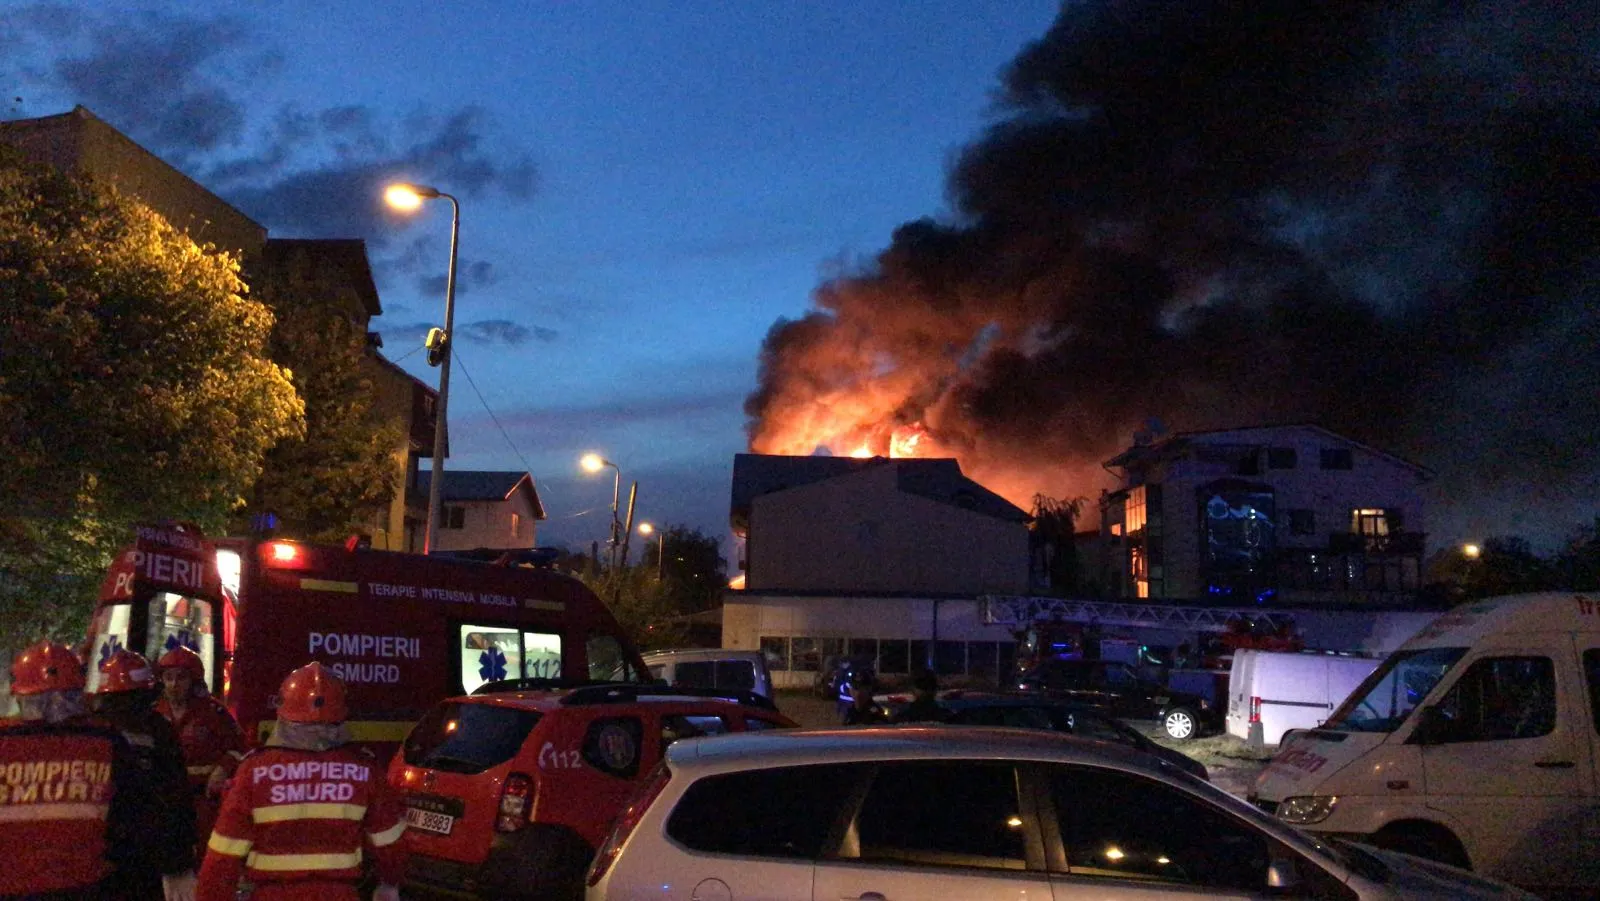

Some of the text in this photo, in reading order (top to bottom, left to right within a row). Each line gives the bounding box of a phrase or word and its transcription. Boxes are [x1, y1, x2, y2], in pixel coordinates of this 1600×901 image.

[368, 583, 517, 607] TERAPIE INTENSIVA MOBILA
[308, 632, 421, 659] POMPIERII
[323, 663, 400, 684] SMURD
[552, 750, 582, 769] 112
[253, 761, 370, 784] POMPIERII
[270, 783, 354, 803] SMURD
[423, 812, 450, 831] 38983
